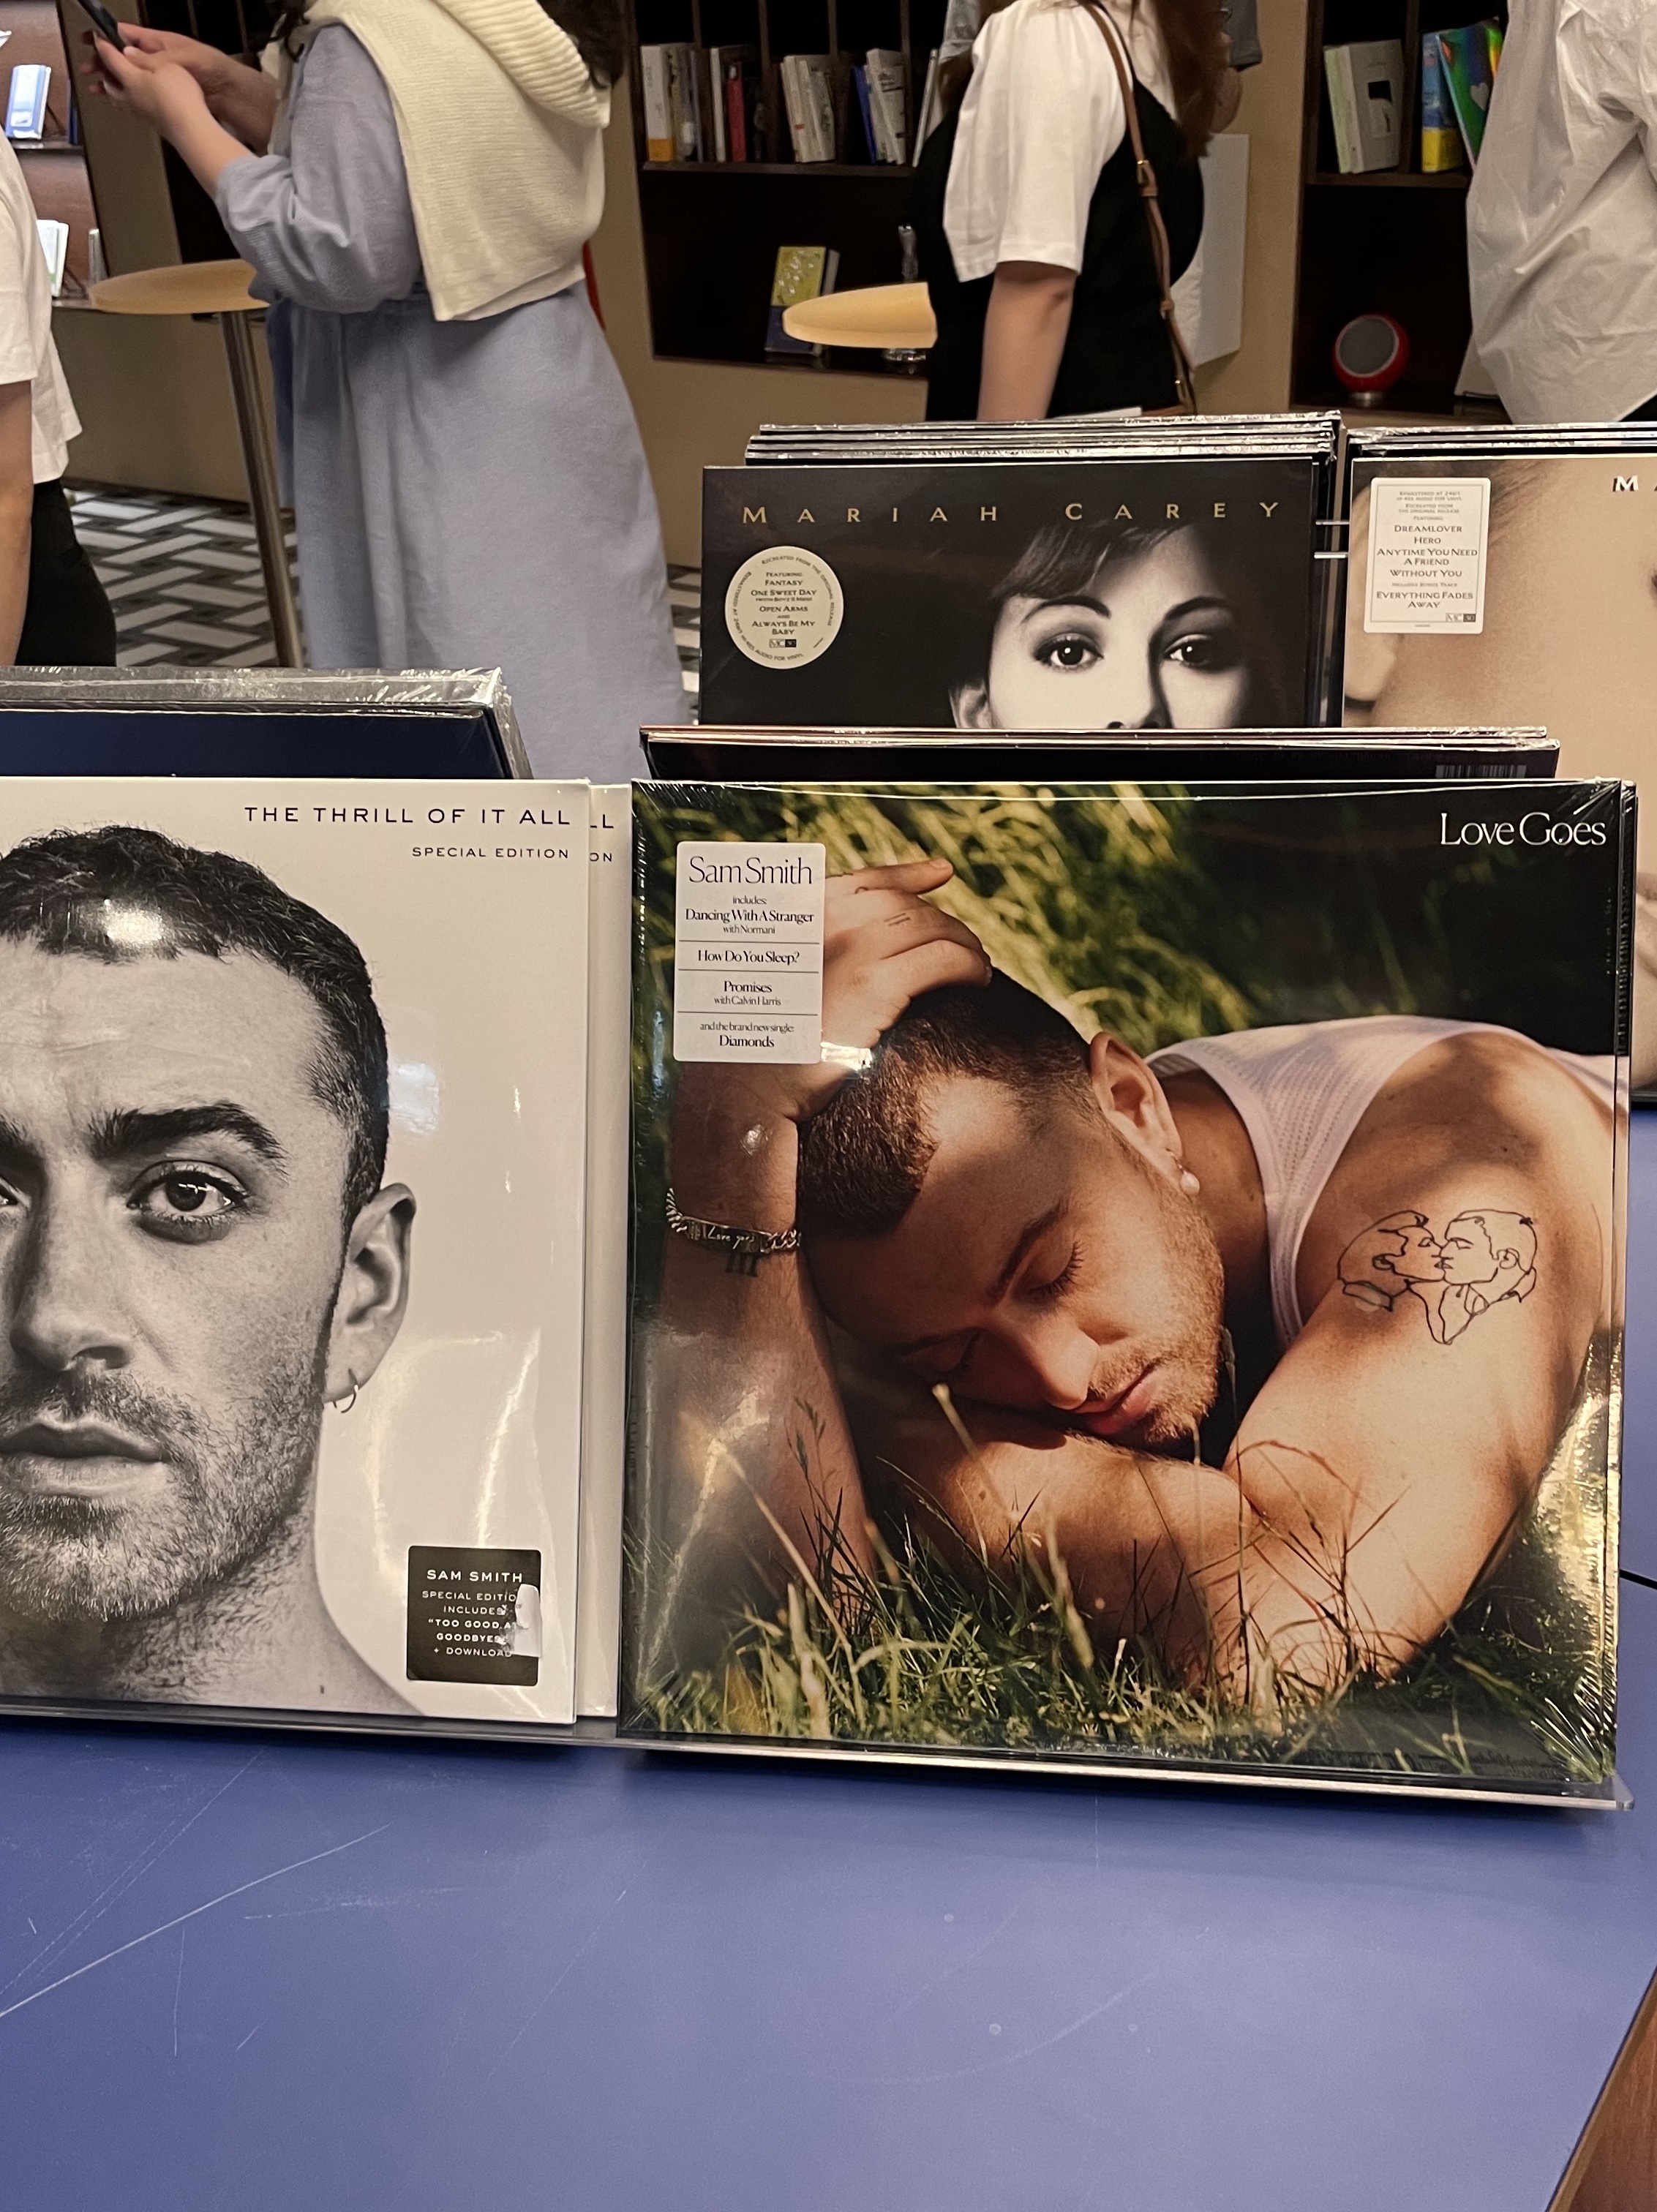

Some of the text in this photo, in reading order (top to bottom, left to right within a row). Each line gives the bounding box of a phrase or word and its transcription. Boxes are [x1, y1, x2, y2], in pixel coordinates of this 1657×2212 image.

[742, 501, 1280, 524] MARIAH CAREY
[1394, 524, 1462, 533] DREAMLOVER
[1413, 536, 1441, 545] HERO
[1376, 548, 1478, 557] ANYTIME YOU NEED
[1415, 558, 1449, 566] FRIEND
[1390, 569, 1462, 578] WITHOUT YOU
[1376, 591, 1473, 600] EVERYTHING FADES
[244, 807, 571, 825] THE THRILL OF IT ALL
[1440, 812, 1607, 846] Love Goes
[412, 846, 569, 859] SPECIAL EDITION
[688, 855, 812, 884] Sam Smith
[685, 908, 814, 925] Dancing With A Stranger
[723, 925, 775, 934] with Normani
[698, 949, 800, 966] How Do You Sleep?
[724, 980, 773, 993] Promises
[714, 996, 781, 1006] with Calvin Harris
[700, 1022, 715, 1030] and
[715, 1022, 729, 1031] the
[729, 1022, 752, 1031] brand
[719, 1034, 775, 1047] Diamonds
[427, 1570, 522, 1583] SAM SMITH
[422, 1590, 516, 1602] SPECIAL EDITIO
[465, 1621, 500, 1629] GOOD
[446, 1647, 513, 1658] DOWNLOAD
